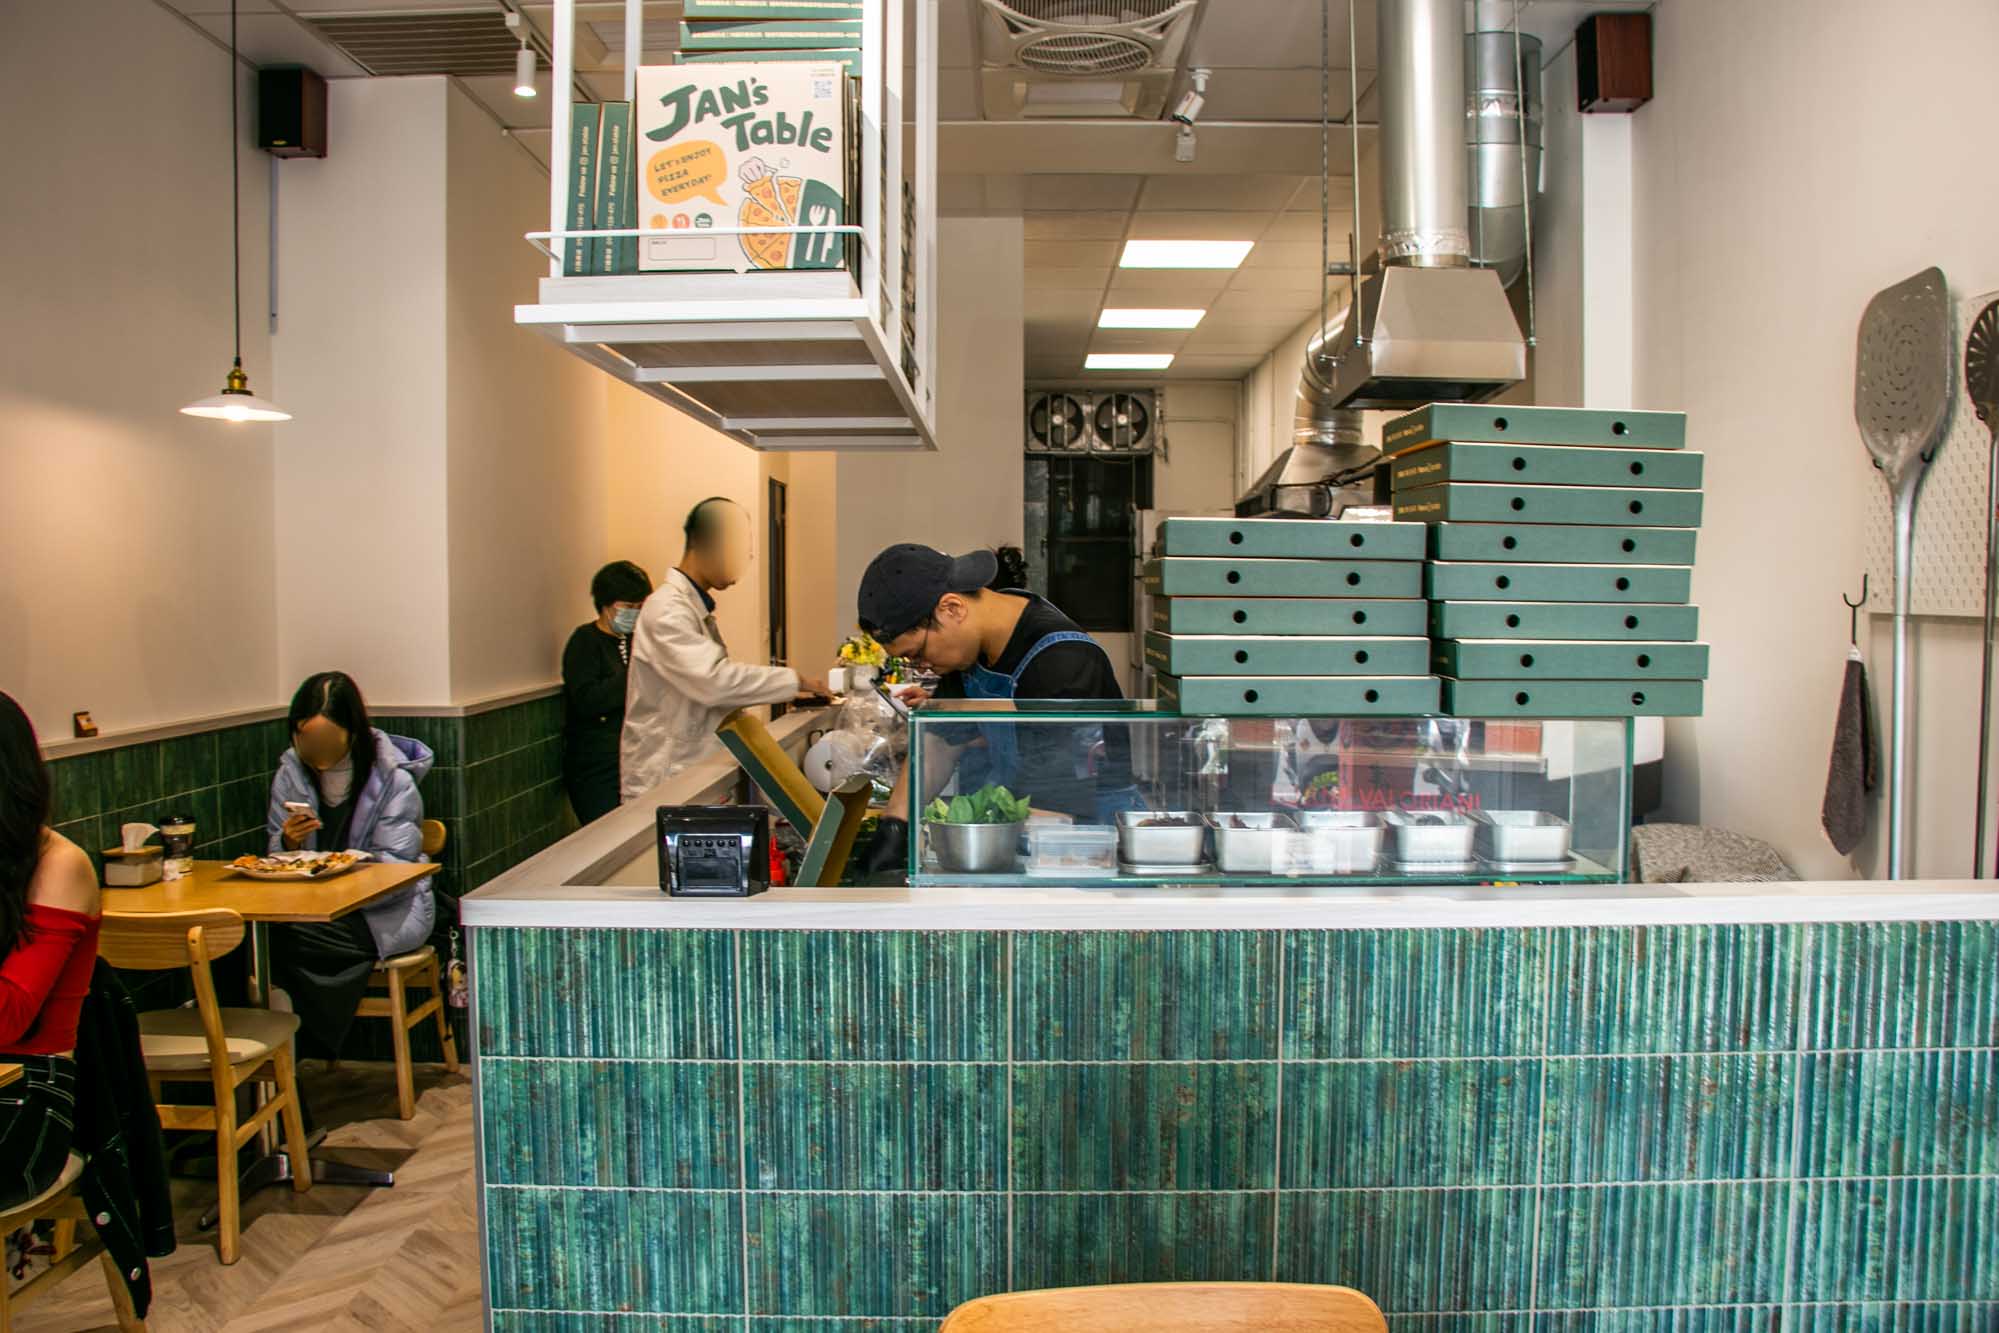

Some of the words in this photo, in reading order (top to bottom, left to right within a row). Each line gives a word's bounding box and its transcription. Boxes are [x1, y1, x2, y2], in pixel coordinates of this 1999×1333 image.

[645, 77, 769, 142] JAN's
[720, 110, 833, 153] Table
[681, 147, 711, 163] ENJOY
[657, 169, 689, 183] PIZZA
